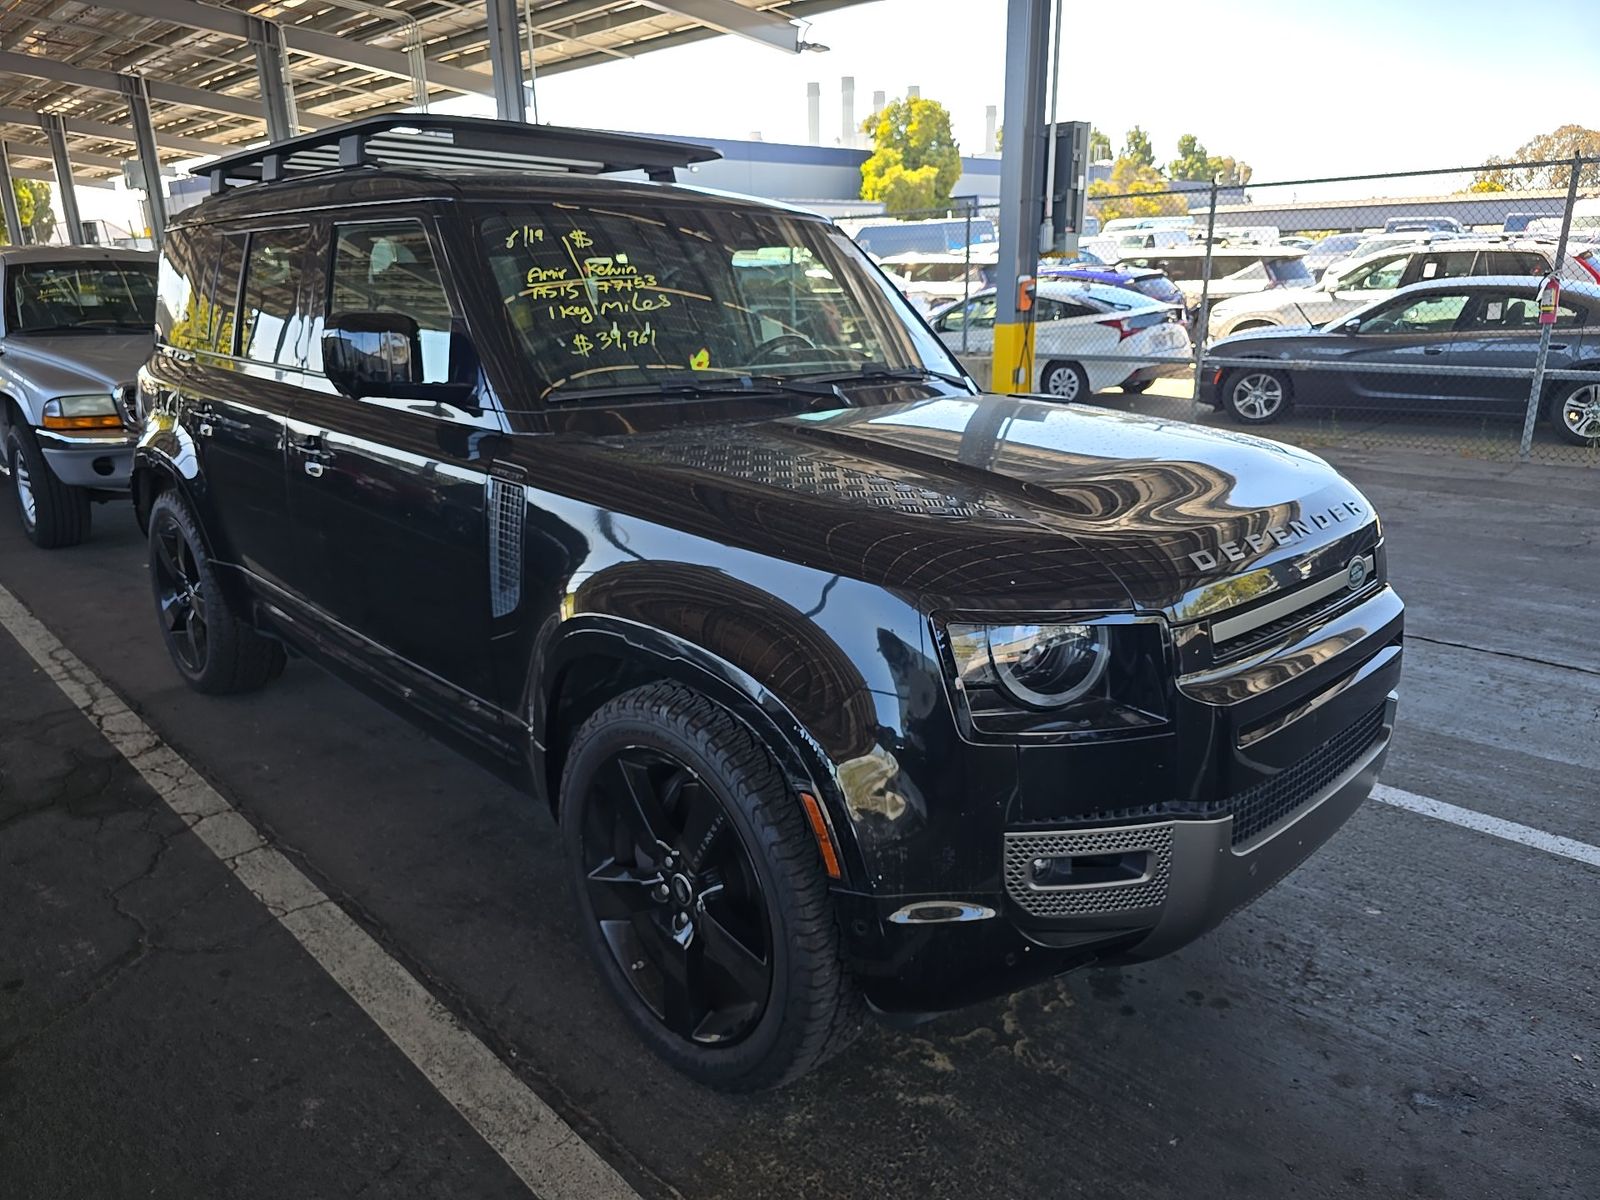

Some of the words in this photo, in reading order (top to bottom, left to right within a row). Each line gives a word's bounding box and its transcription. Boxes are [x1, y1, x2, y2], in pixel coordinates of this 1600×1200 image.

[568, 228, 594, 249] $
[526, 266, 568, 283] Amir
[1188, 500, 1364, 572] DEFENDER
